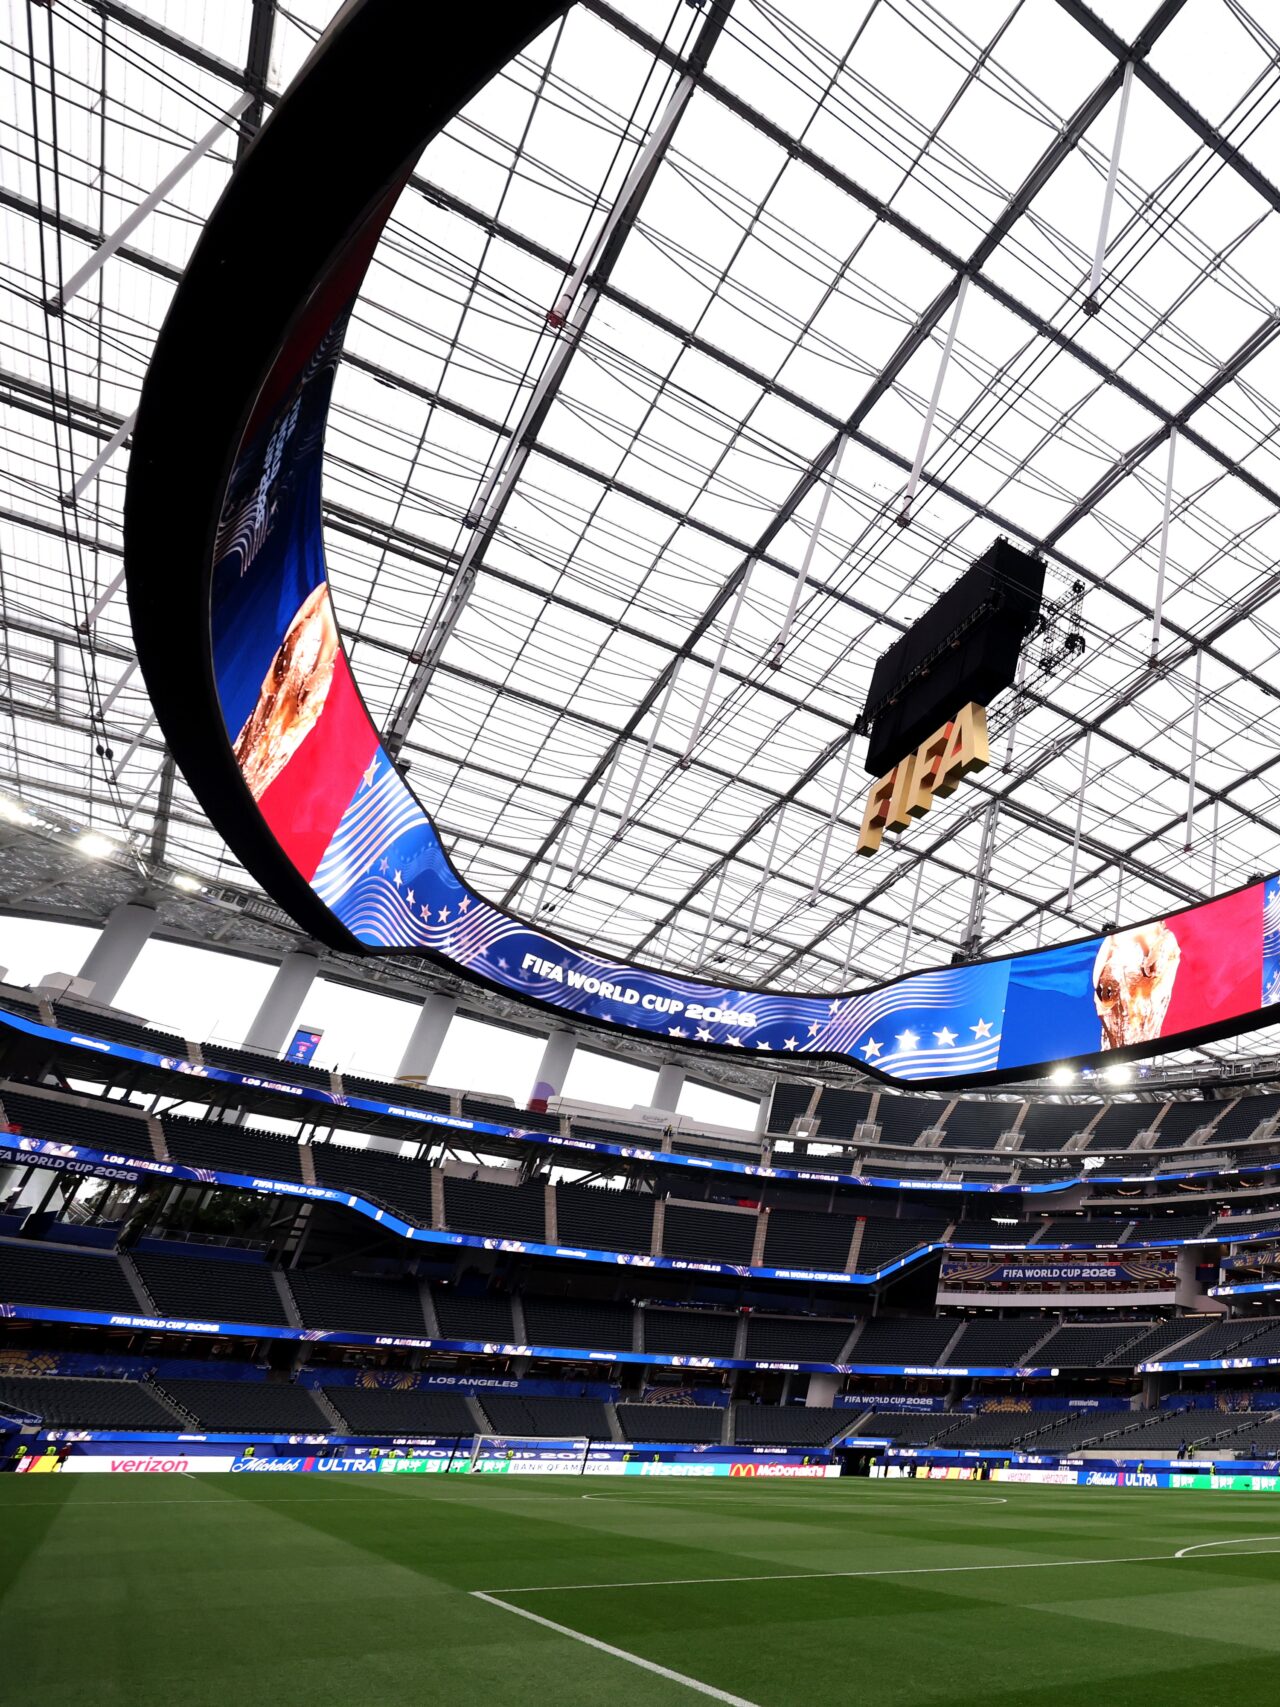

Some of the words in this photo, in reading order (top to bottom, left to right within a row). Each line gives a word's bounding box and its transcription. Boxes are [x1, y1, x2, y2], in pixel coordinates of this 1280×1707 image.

[857, 701, 989, 857] FIFA
[521, 953, 564, 984] FIFA
[567, 969, 640, 1005] WORLD
[641, 994, 684, 1015] CUP
[684, 1003, 757, 1027] 2026
[242, 1076, 260, 1086] LOS
[261, 1080, 302, 1094] ANGELES
[548, 1136, 562, 1145] LOS
[564, 1139, 595, 1150] ANGELES
[16, 1153, 64, 1168] WORLD
[66, 1162, 93, 1174] CUP
[95, 1166, 138, 1181] 2026
[103, 1154, 125, 1165] LOS
[127, 1158, 173, 1174] ANGELES
[672, 1260, 686, 1268] LOS
[688, 1262, 721, 1272] ANGELES
[1003, 1269, 1023, 1278] FIFA
[1025, 1269, 1058, 1278] WORLD
[1061, 1269, 1081, 1278] CUP
[1082, 1268, 1116, 1278] 2026
[110, 1316, 131, 1325] FIFA
[132, 1317, 166, 1328] WORLD
[167, 1320, 187, 1330] CUP
[186, 1322, 219, 1332] 2026
[376, 1337, 392, 1345] LOS
[393, 1338, 431, 1348] ANGELES
[428, 1376, 455, 1385] LOS
[458, 1377, 518, 1388] ANGELES
[844, 1396, 859, 1404] FIFA
[862, 1396, 888, 1404] WORLD
[890, 1397, 905, 1405] CUP
[906, 1397, 933, 1406] 2026
[355, 1448, 405, 1456] FFA
[412, 1449, 490, 1458] WORLD
[494, 1450, 536, 1459] CUP
[540, 1451, 611, 1460] 2026
[110, 1457, 188, 1472] verizon
[232, 1457, 301, 1473] Michelob
[317, 1459, 377, 1472] ULTRA
[513, 1463, 542, 1471] BANK
[547, 1463, 559, 1471] OF
[563, 1463, 610, 1472] AMERICA
[641, 1462, 715, 1476] Hisense
[756, 1465, 825, 1477] McDonald's
[1125, 1474, 1157, 1486] ULTRA
